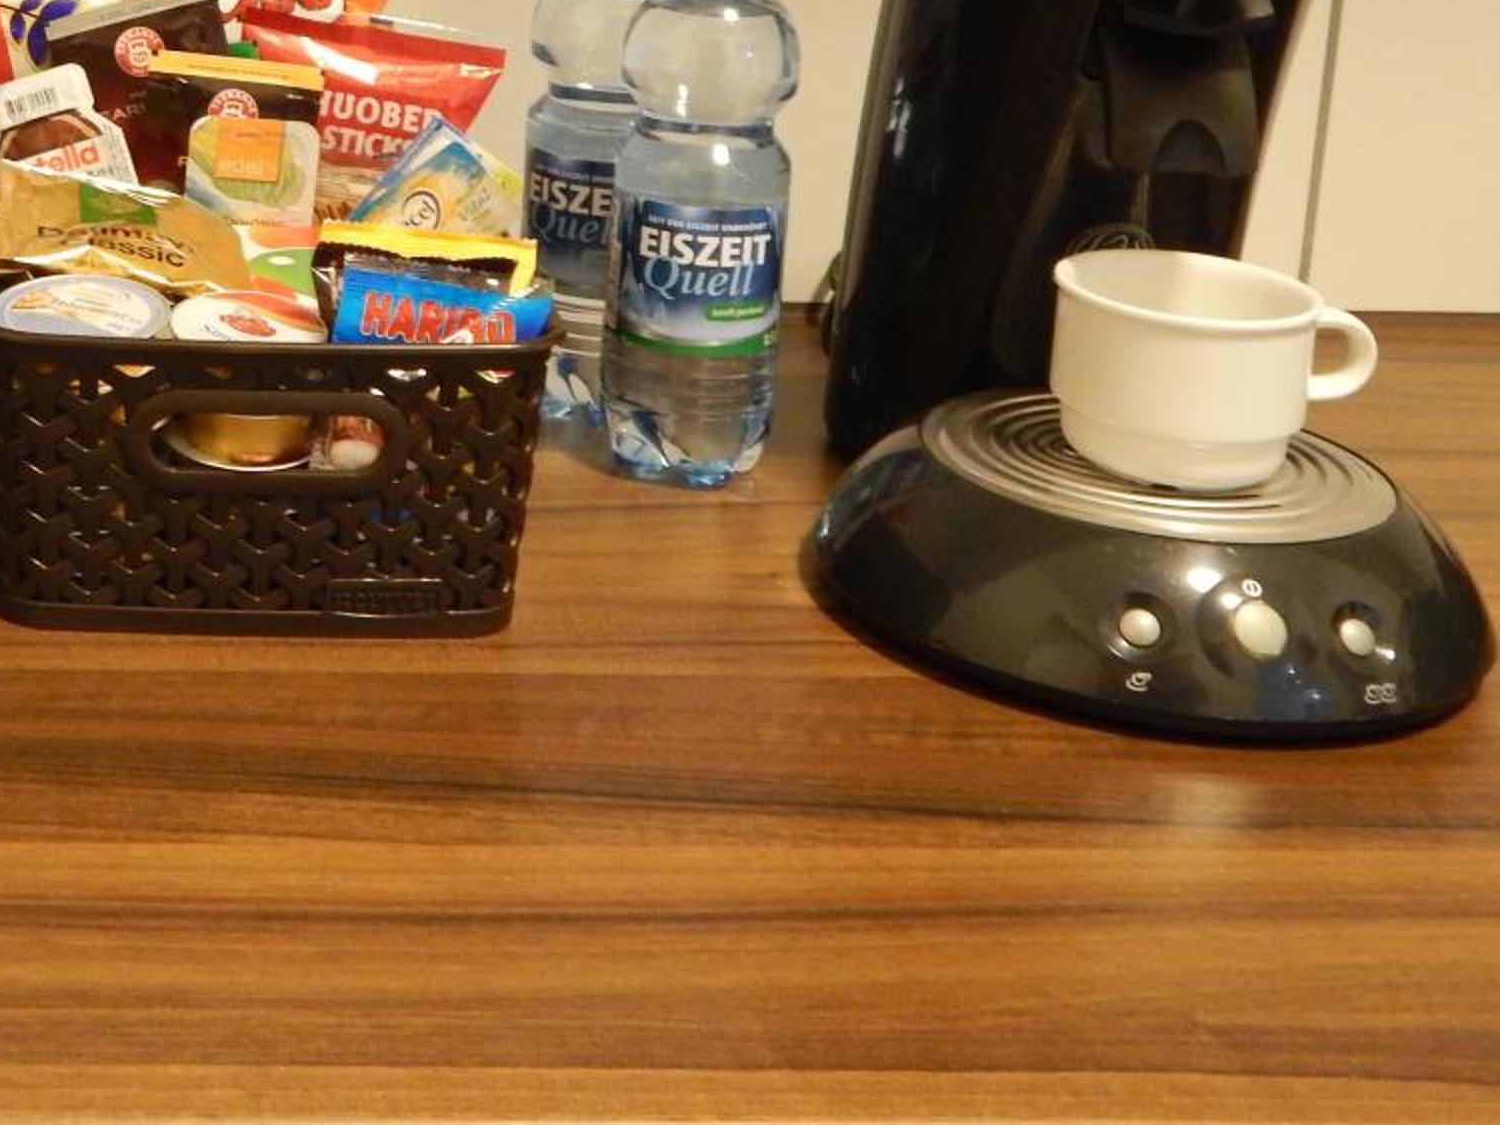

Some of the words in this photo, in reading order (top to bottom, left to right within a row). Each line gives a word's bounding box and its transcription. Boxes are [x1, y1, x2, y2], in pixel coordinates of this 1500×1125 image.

[322, 125, 412, 158] STICK
[529, 172, 615, 216] EISZE
[531, 199, 613, 245] Quel
[639, 226, 772, 268] EISZEIT
[644, 256, 755, 300] Quell
[360, 288, 517, 344] HARIBO
